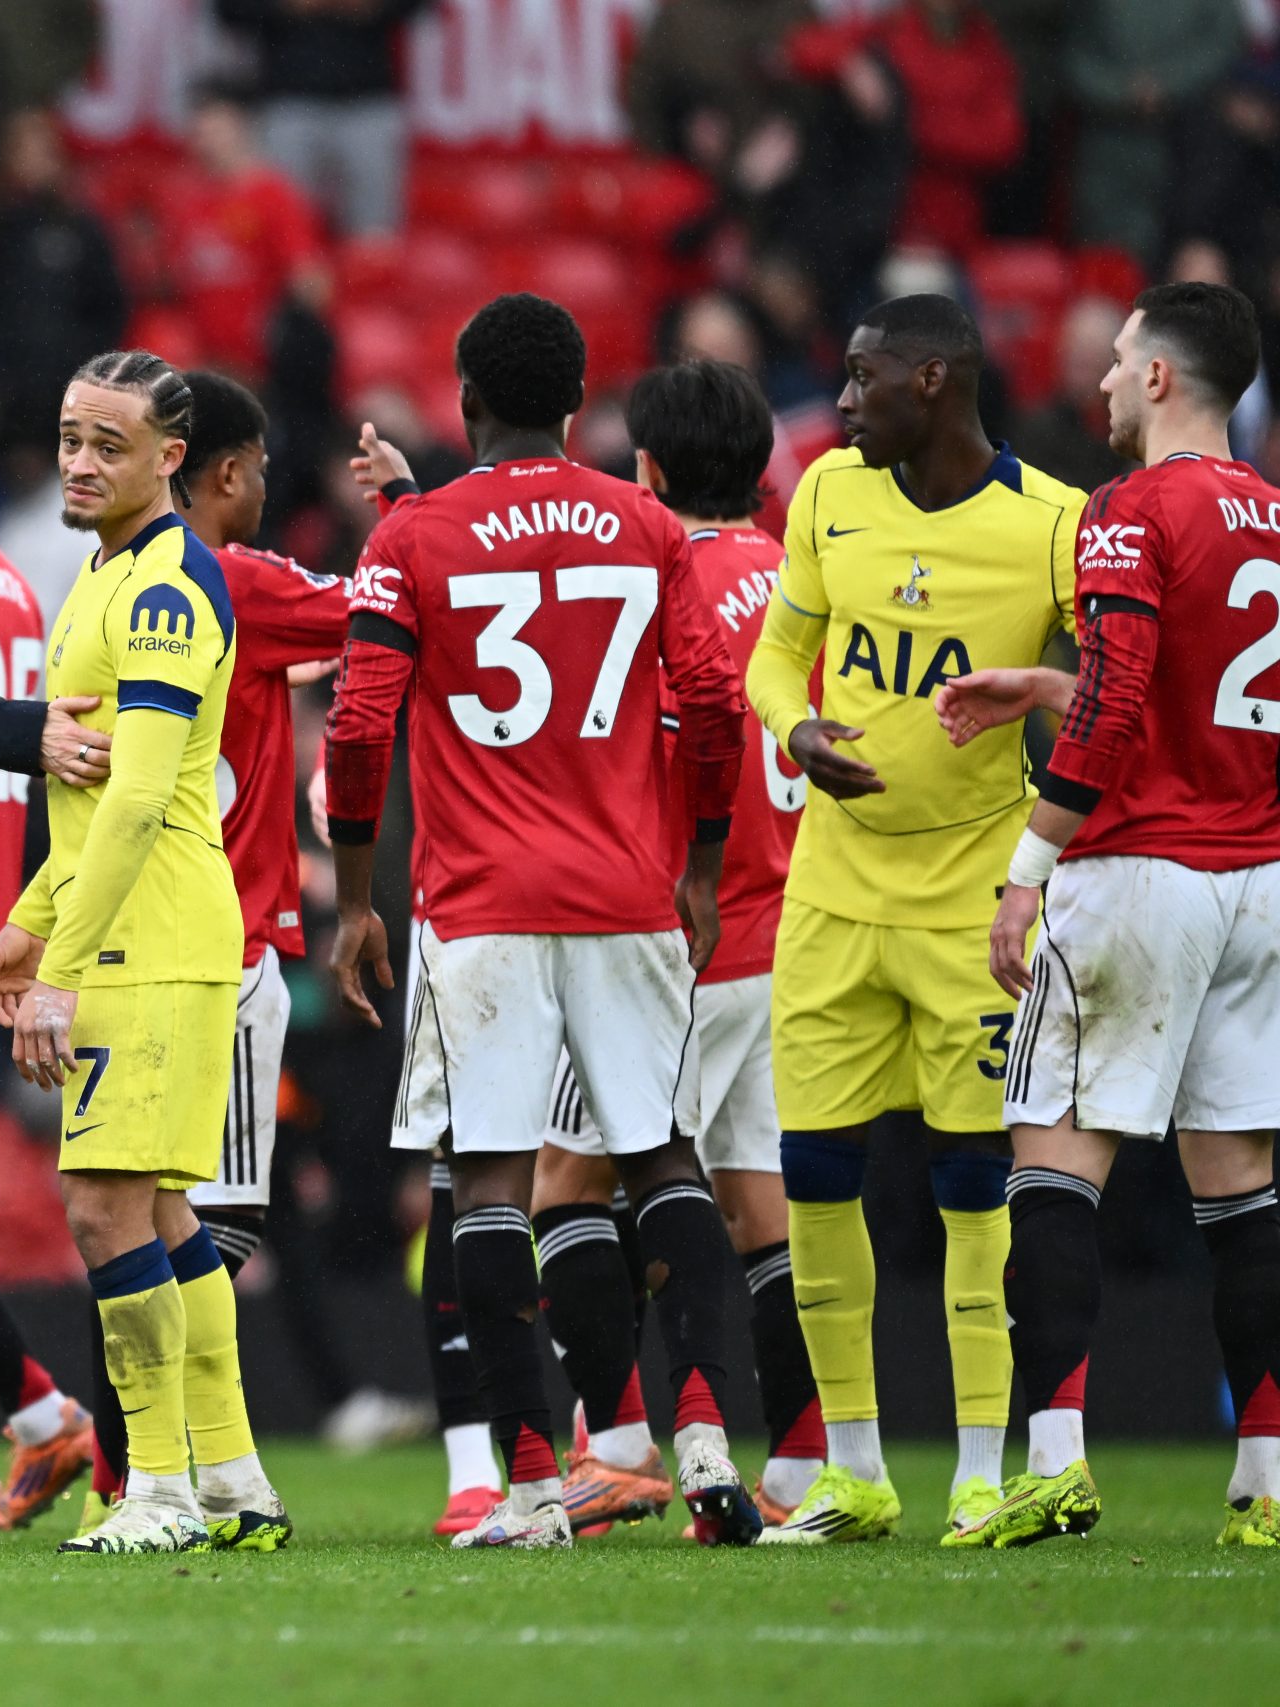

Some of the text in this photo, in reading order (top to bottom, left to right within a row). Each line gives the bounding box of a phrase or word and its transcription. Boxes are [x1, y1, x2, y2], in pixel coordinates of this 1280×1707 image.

[470, 500, 621, 552] MAINOO
[1081, 558, 1140, 574] HNOLOGY
[717, 569, 779, 634] MART
[128, 637, 191, 659] kraken
[447, 565, 659, 748] 37
[837, 622, 973, 699] AIA
[1213, 558, 1280, 734] 2
[73, 1046, 111, 1118] 7
